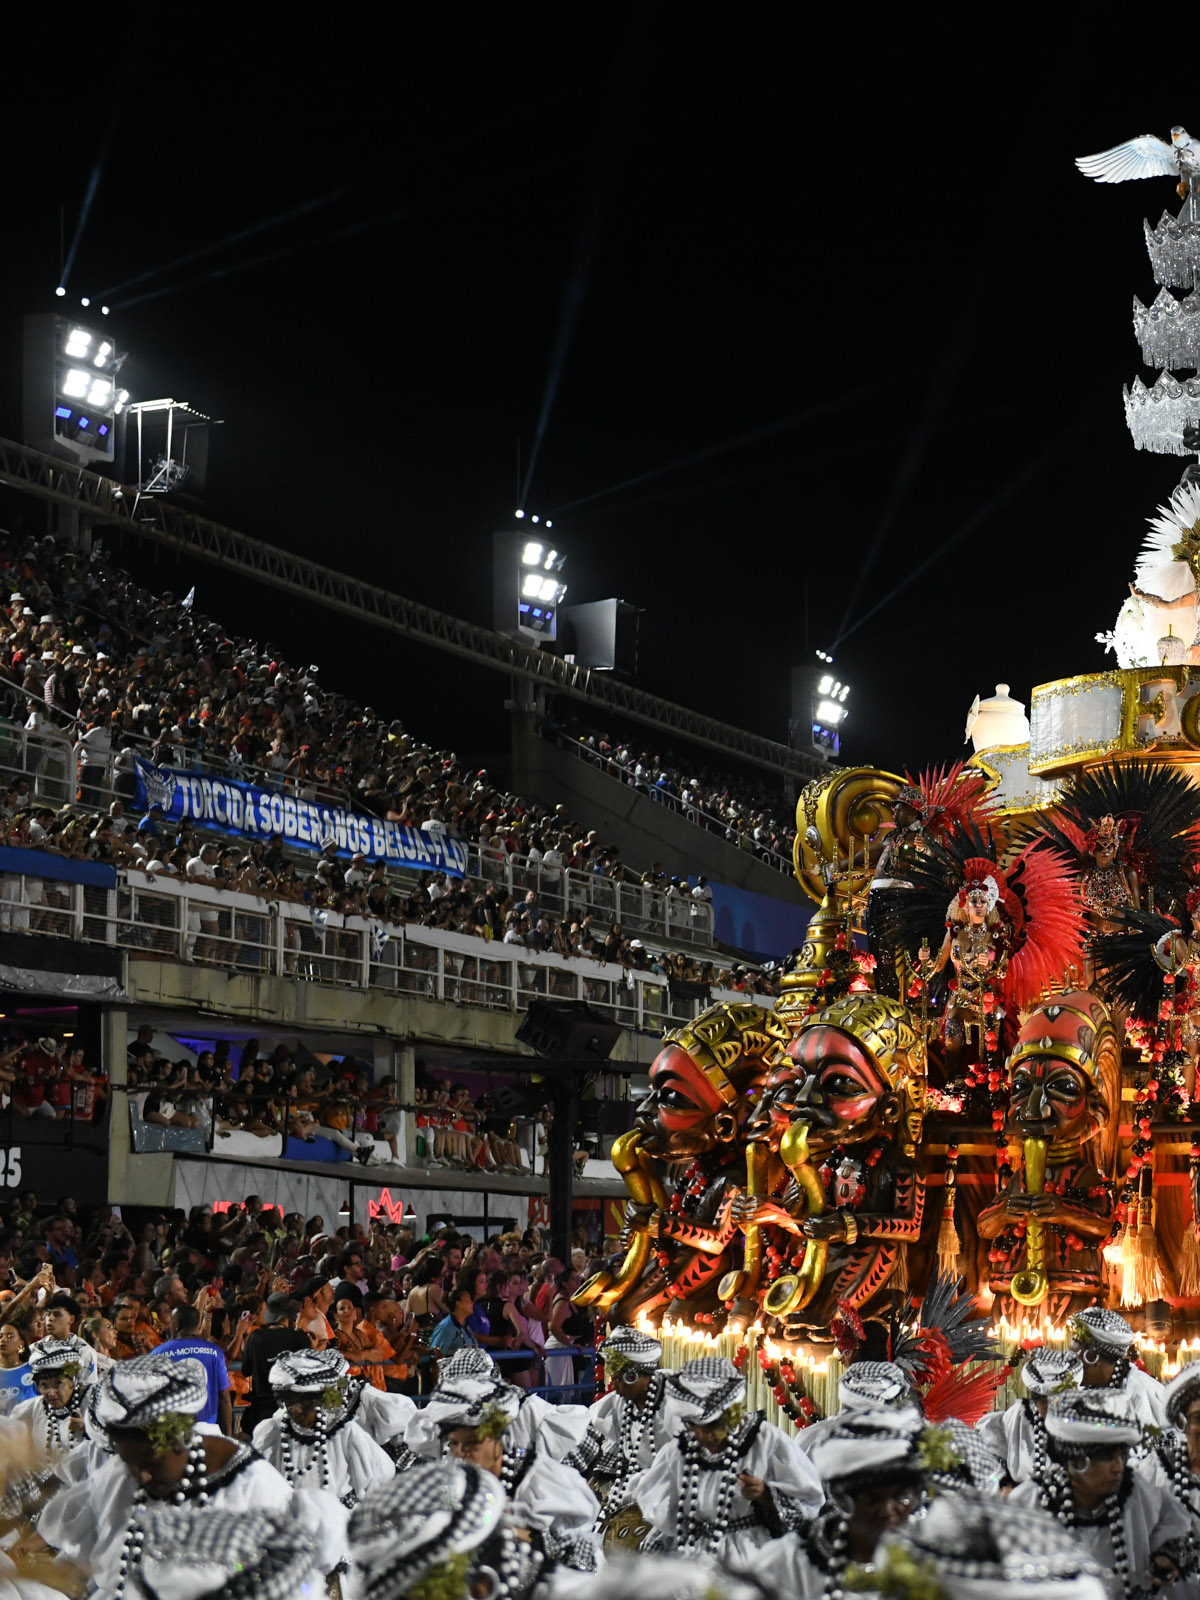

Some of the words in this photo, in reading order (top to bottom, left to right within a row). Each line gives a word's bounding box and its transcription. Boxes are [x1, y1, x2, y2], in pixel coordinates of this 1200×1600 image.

[175, 775, 259, 833] TORCIDA
[258, 792, 371, 856] SOBERANOS
[158, 1346, 218, 1357] UIA-MOTORISTA
